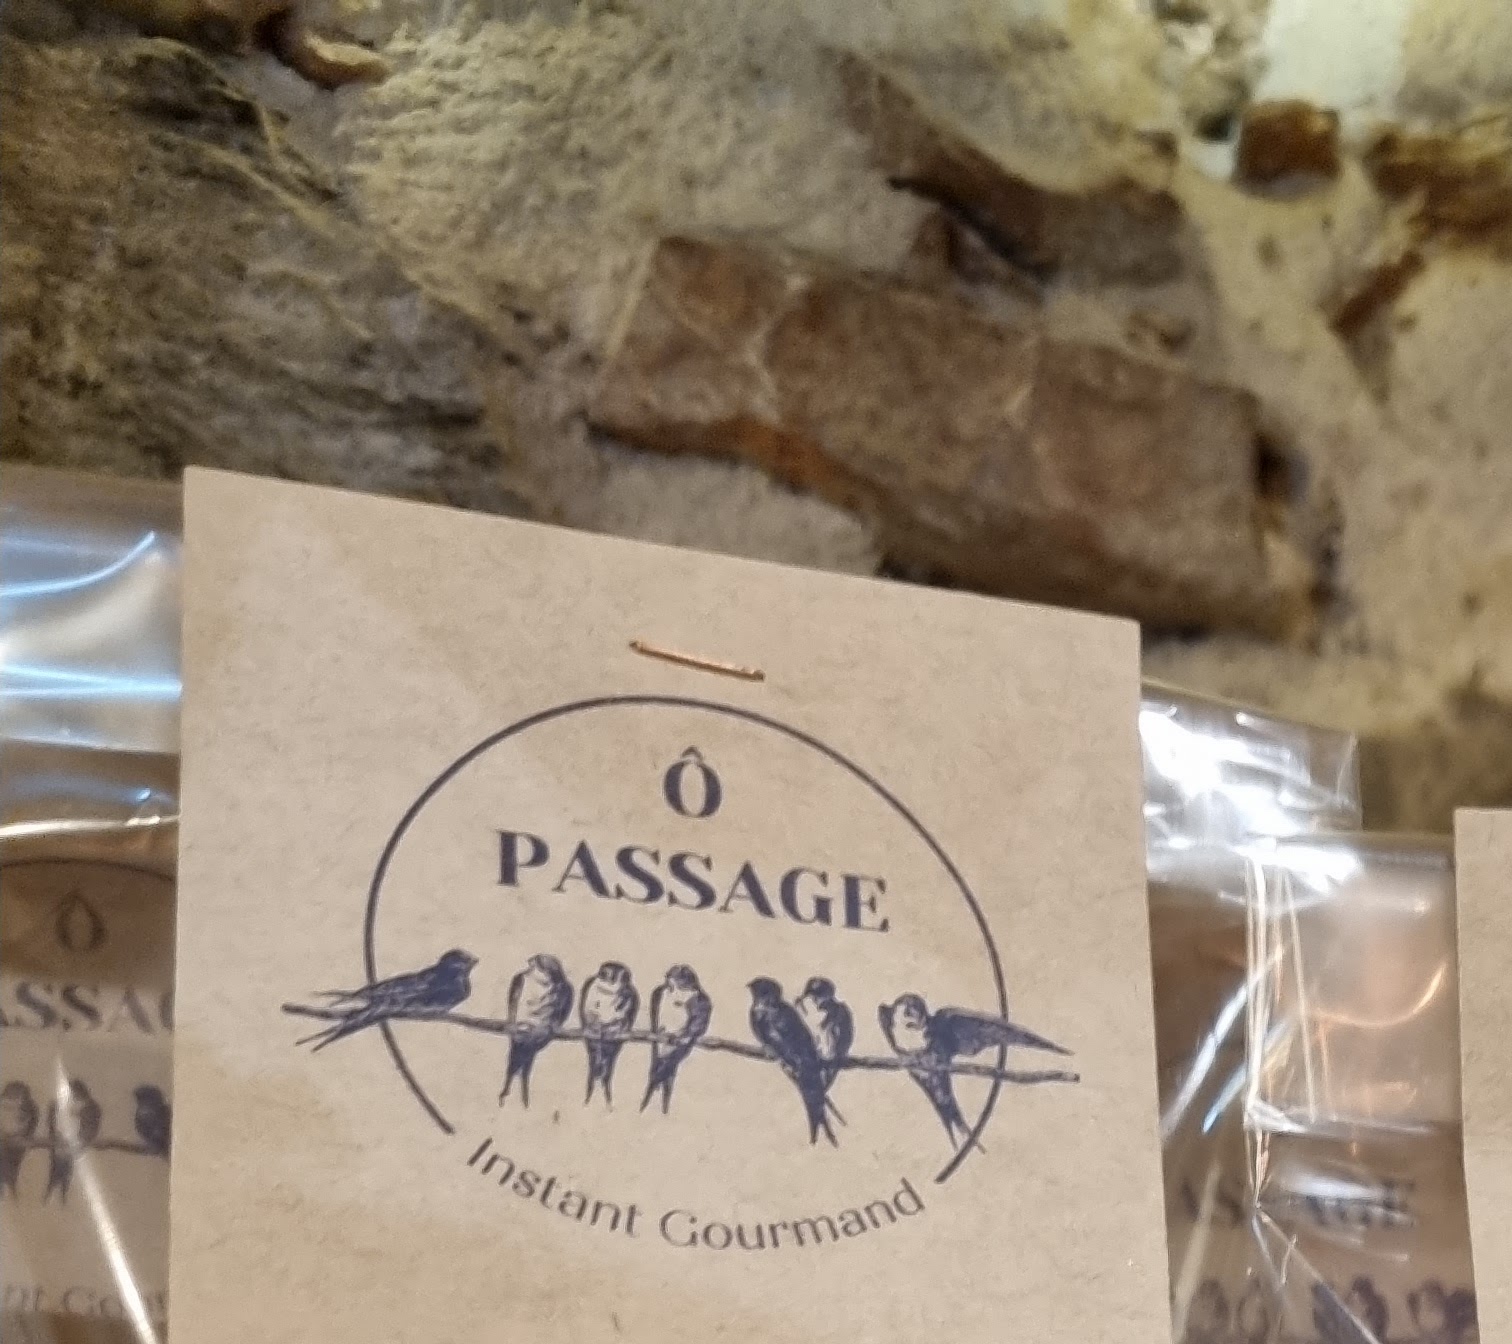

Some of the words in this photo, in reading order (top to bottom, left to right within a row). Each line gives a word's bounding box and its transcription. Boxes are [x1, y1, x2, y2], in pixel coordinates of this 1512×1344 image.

[662, 744, 723, 819] Ô
[495, 828, 890, 932] PASSAGE
[466, 1136, 642, 1239] Instant
[658, 1176, 927, 1252] Gourmand
